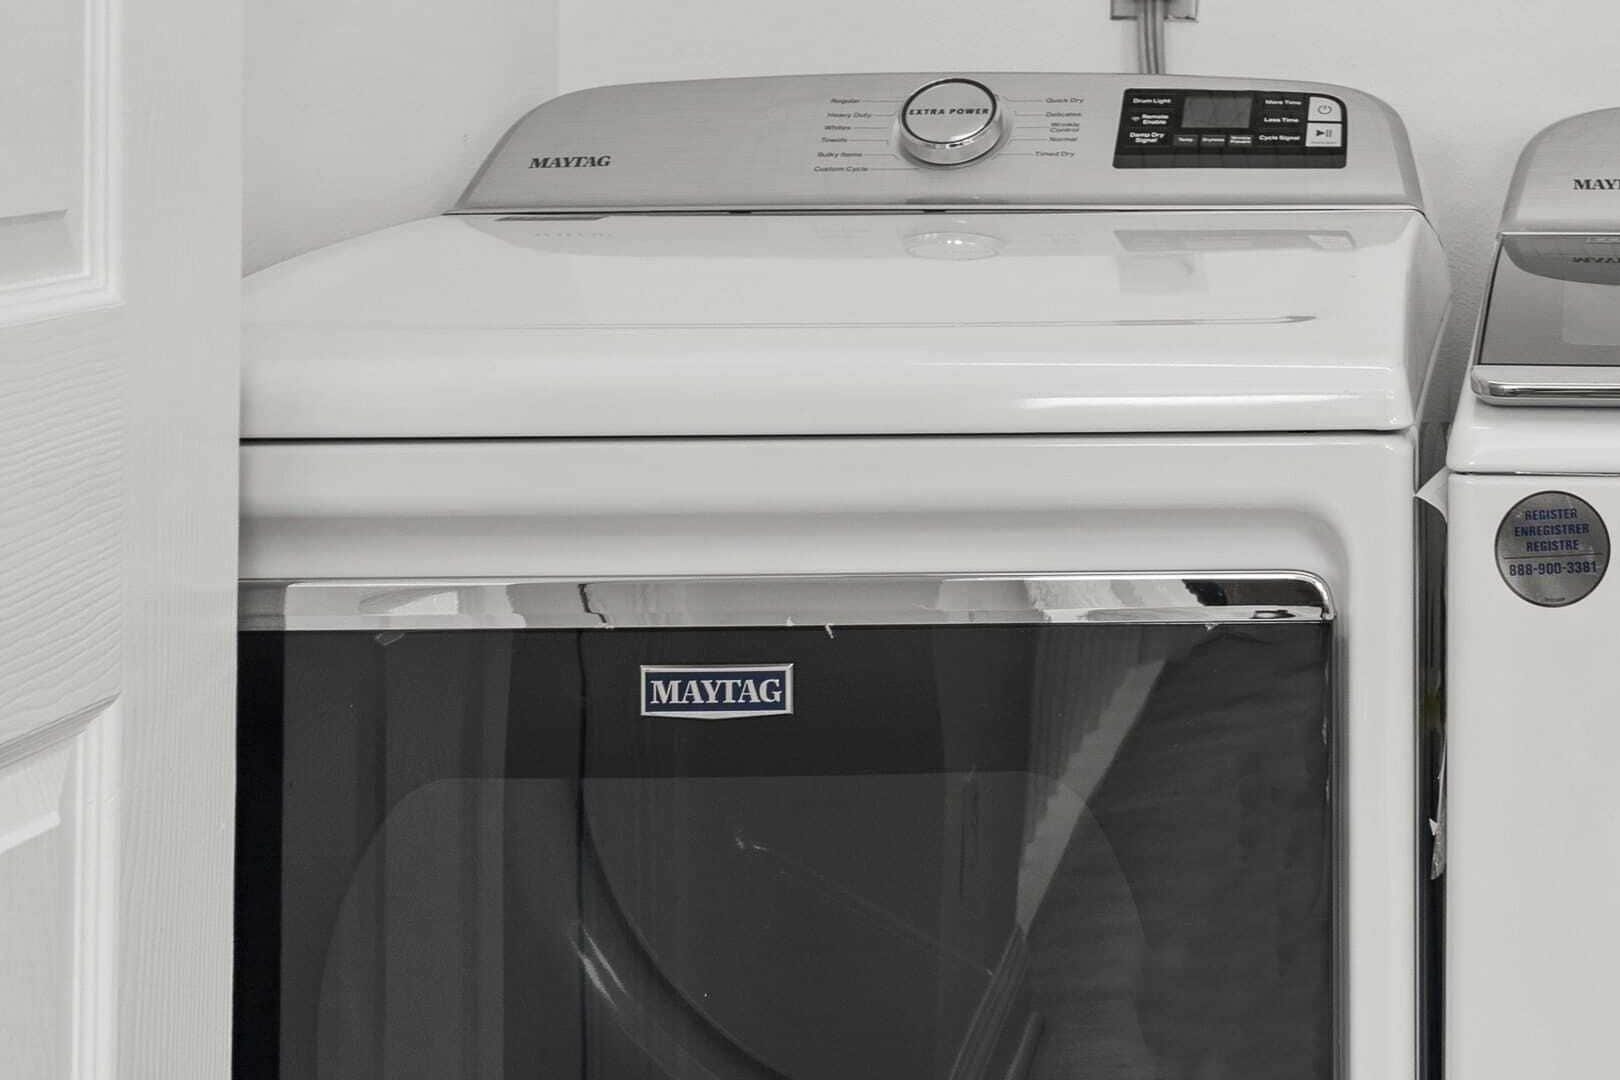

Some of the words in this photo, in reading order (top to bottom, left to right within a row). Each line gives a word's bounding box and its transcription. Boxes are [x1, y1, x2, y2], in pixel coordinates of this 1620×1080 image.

[949, 107, 989, 115] POWER
[528, 155, 611, 169] MAYTAG
[1525, 508, 1577, 521] REGISTER
[1514, 523, 1590, 537] ENREGISTRER
[1526, 539, 1580, 552] REGISTRE
[650, 678, 783, 704] MAYTAG
